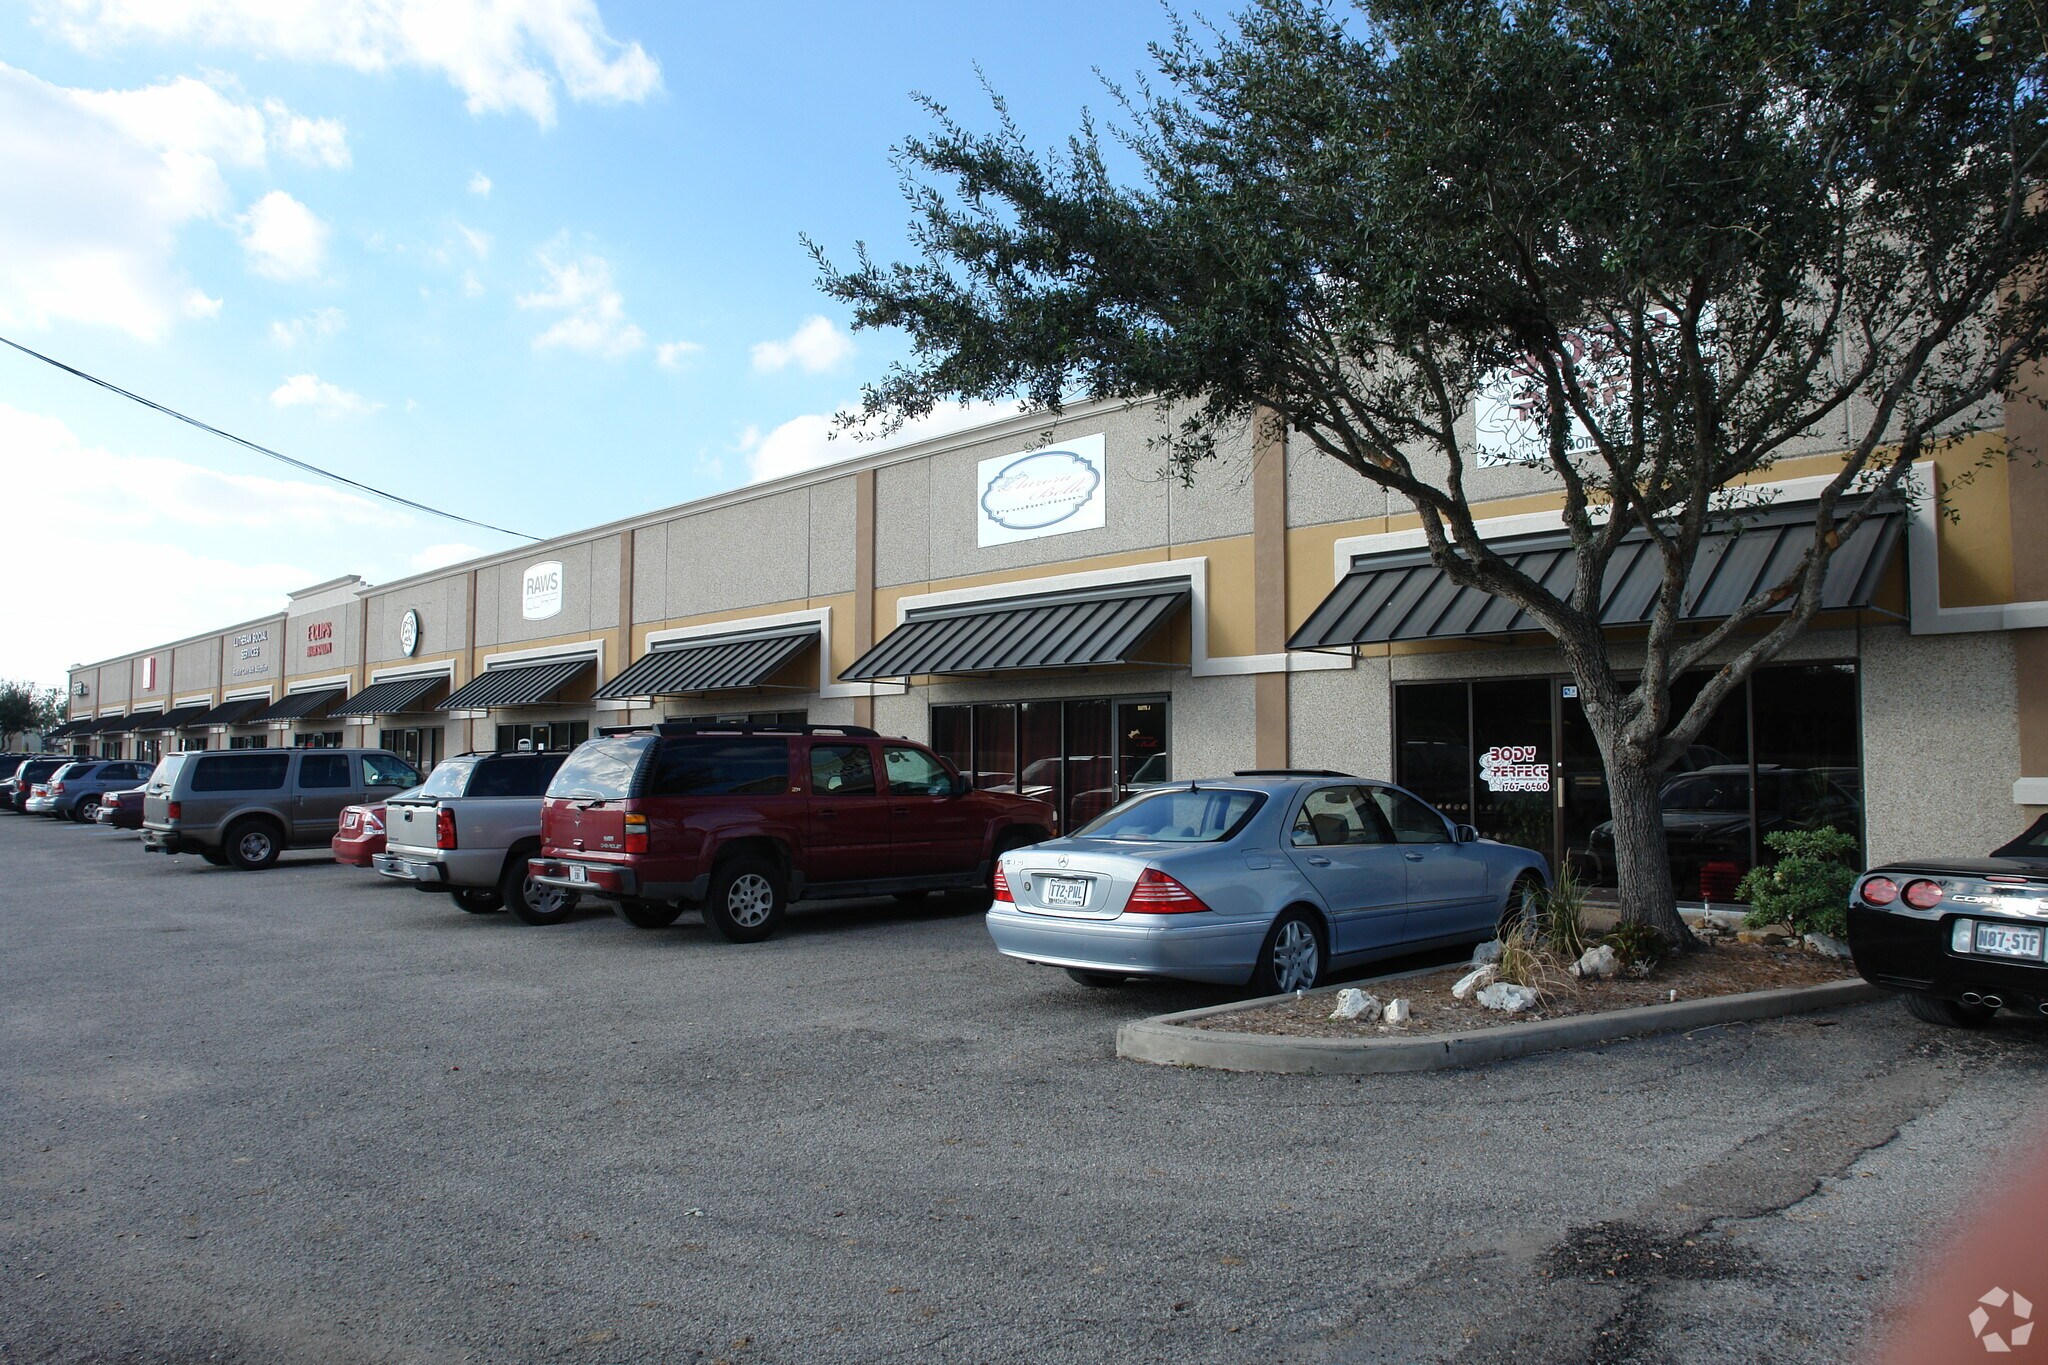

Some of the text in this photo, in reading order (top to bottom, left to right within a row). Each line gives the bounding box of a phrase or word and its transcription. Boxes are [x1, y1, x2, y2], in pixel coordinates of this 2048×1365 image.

[526, 572, 558, 595] RAWS
[526, 592, 559, 611] CORP
[1490, 747, 1535, 761] BODY
[1491, 766, 1548, 777] PERFECT
